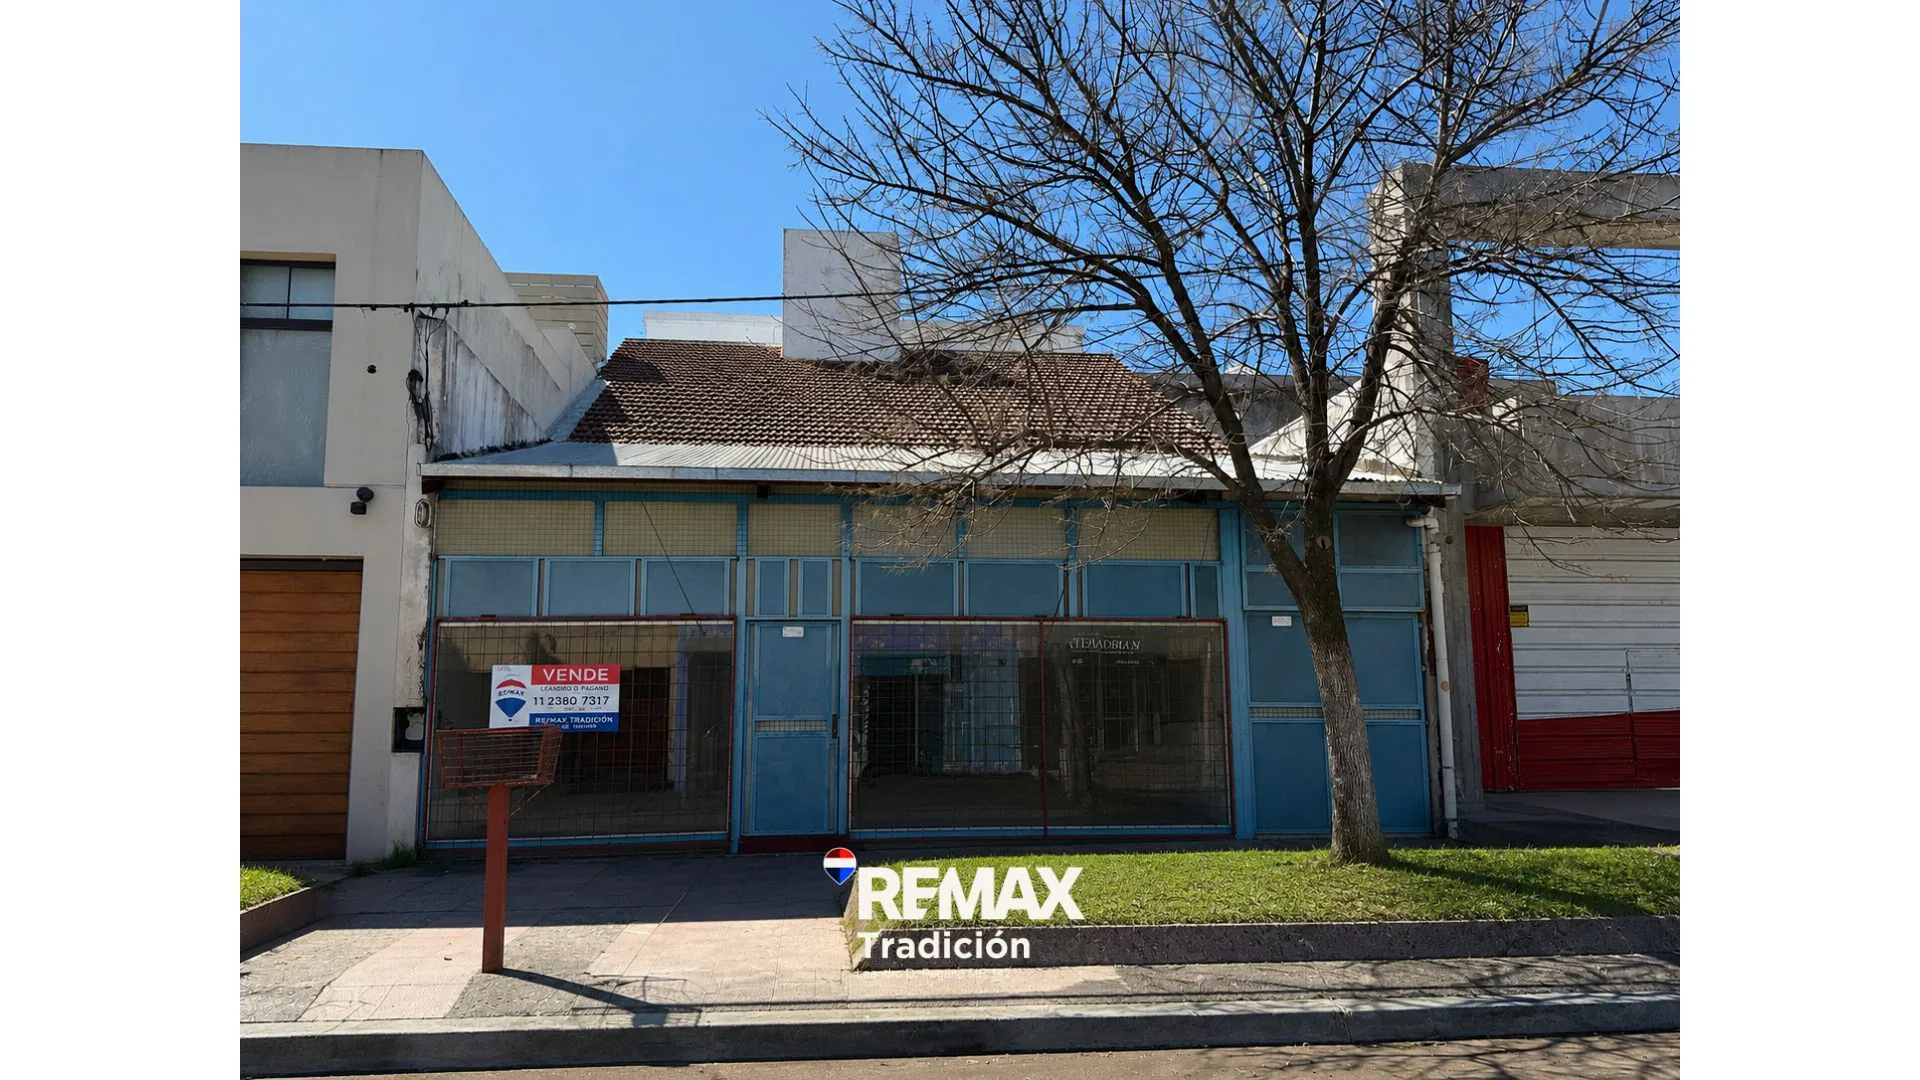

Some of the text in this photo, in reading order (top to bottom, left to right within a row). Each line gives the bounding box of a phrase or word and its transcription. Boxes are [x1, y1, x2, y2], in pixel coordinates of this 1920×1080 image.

[543, 668, 609, 681] VENDE
[533, 696, 610, 706] 11 2380 7317
[570, 714, 613, 724] TRADICIÓN
